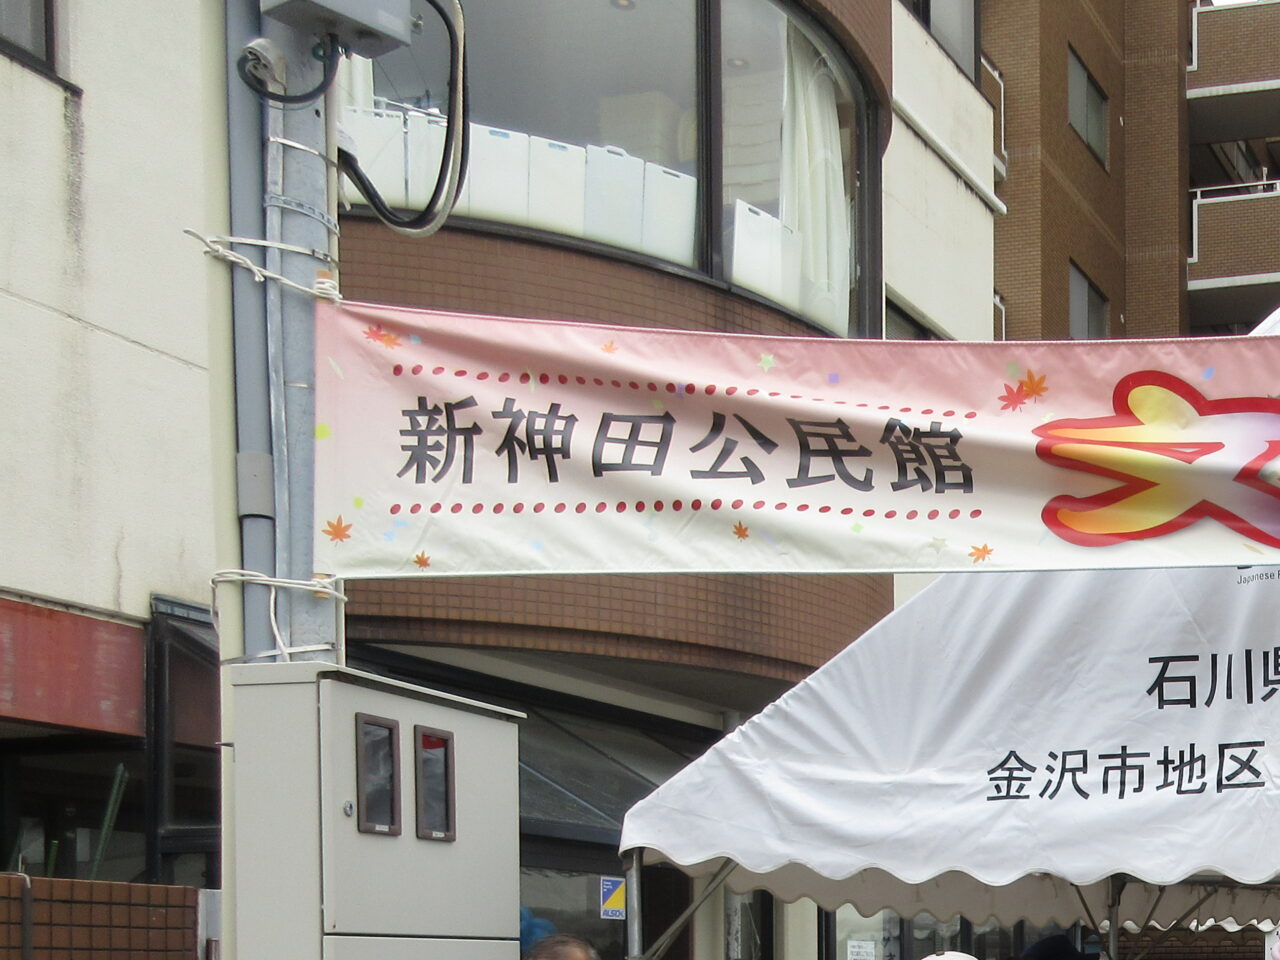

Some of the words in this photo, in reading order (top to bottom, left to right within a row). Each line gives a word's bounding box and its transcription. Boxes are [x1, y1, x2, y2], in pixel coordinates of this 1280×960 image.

[396, 395, 978, 495] 新神田公民館
[1237, 573, 1275, 585] Japanese
[986, 740, 1267, 801] 金沢市地区
